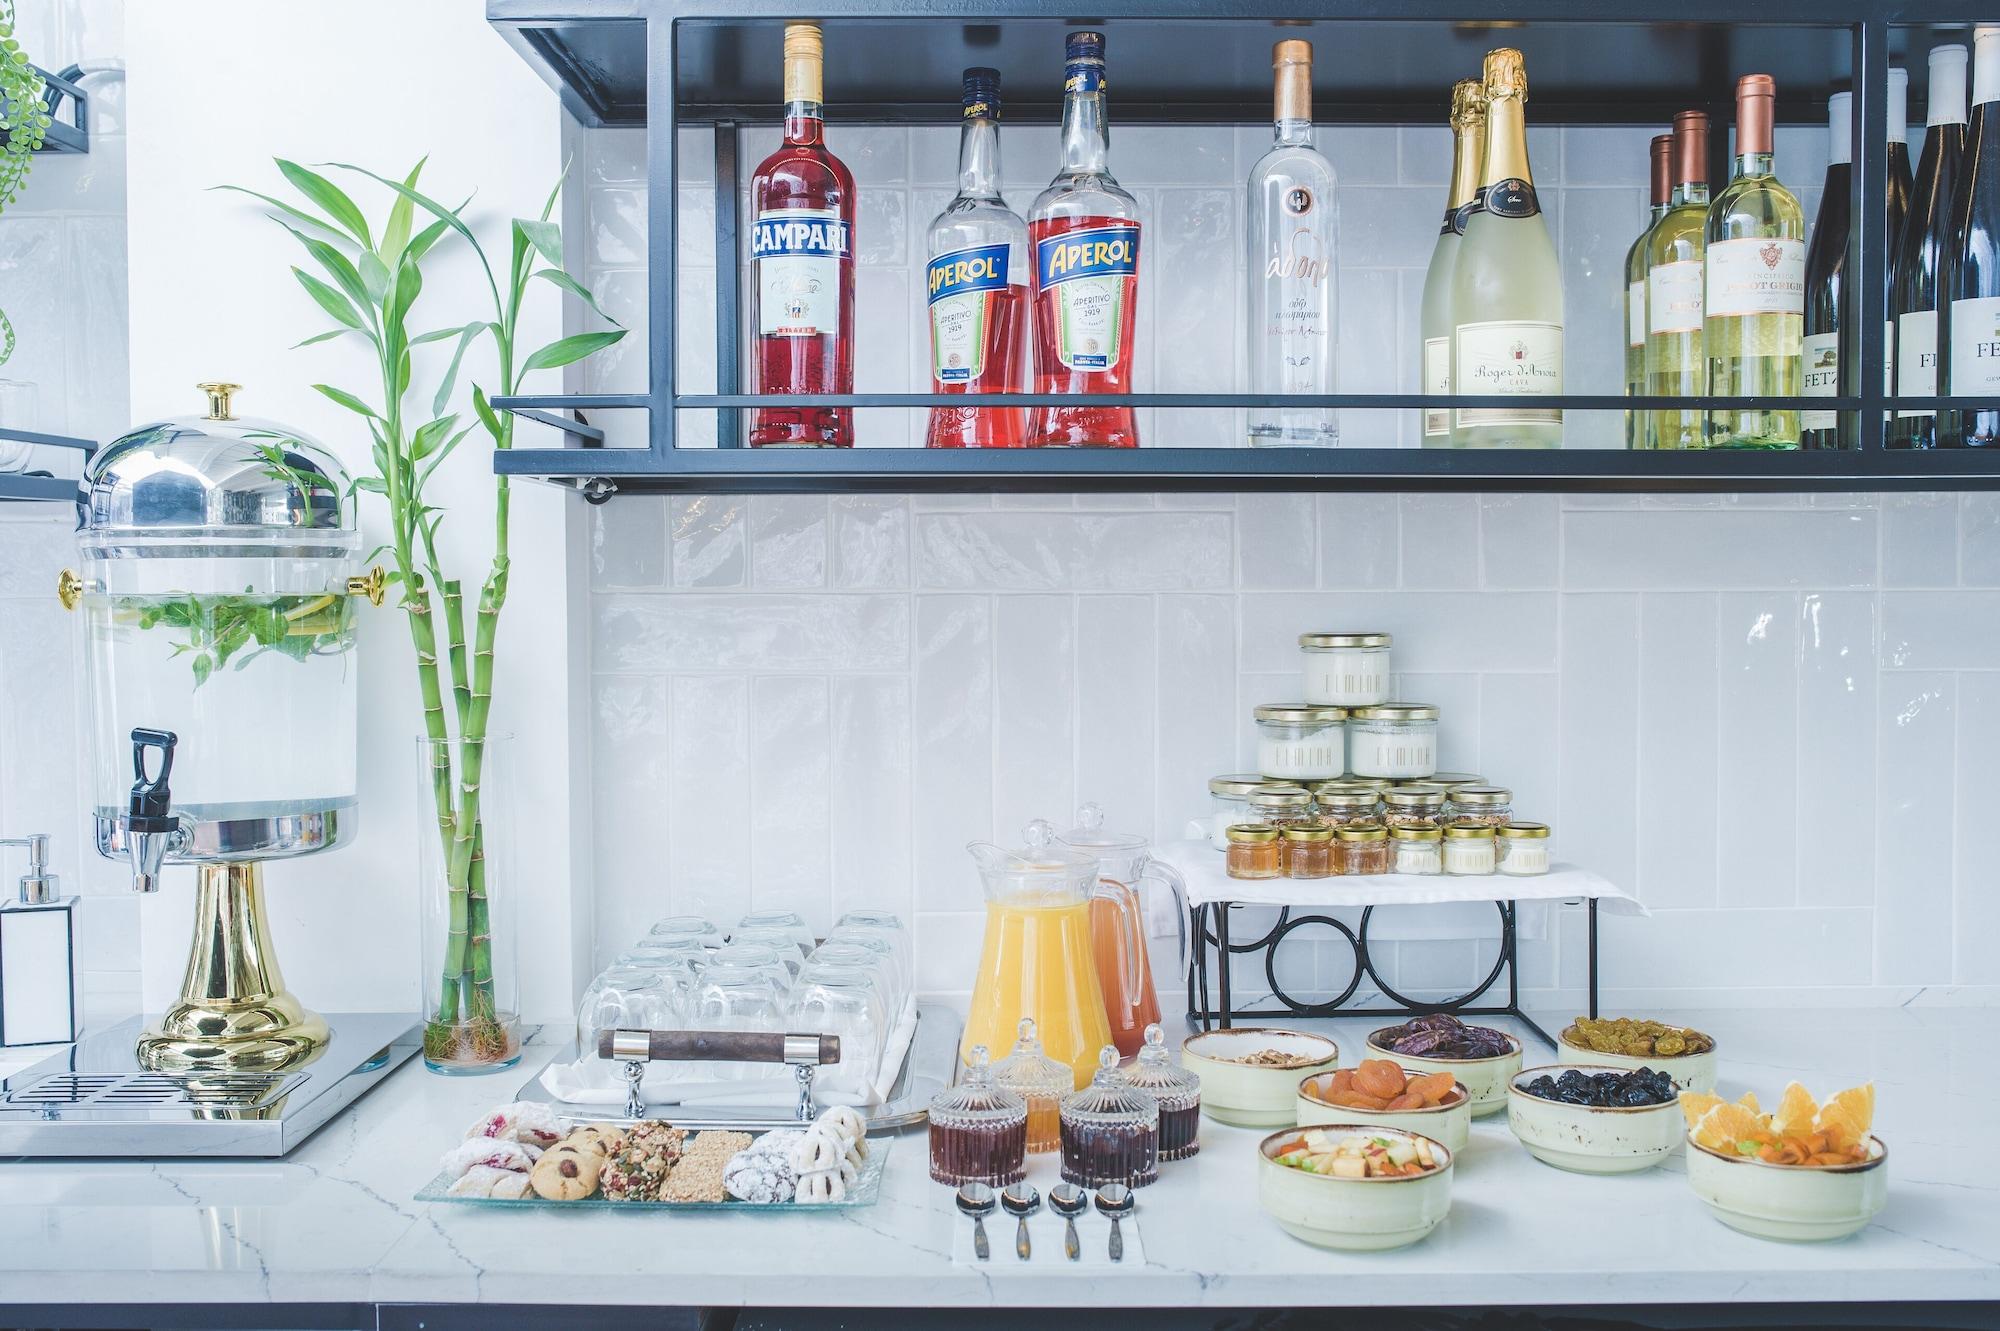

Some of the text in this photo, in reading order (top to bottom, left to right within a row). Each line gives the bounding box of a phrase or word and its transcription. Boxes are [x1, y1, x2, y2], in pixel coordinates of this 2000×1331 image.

[752, 223, 847, 253] CAMPARI
[1048, 239, 1132, 279] APEROL
[928, 256, 998, 299] APEROL
[1072, 293, 1111, 307] APERITIVO
[1084, 308, 1101, 317] 1919
[948, 324, 962, 334] 1919
[1474, 363, 1514, 384] Roger
